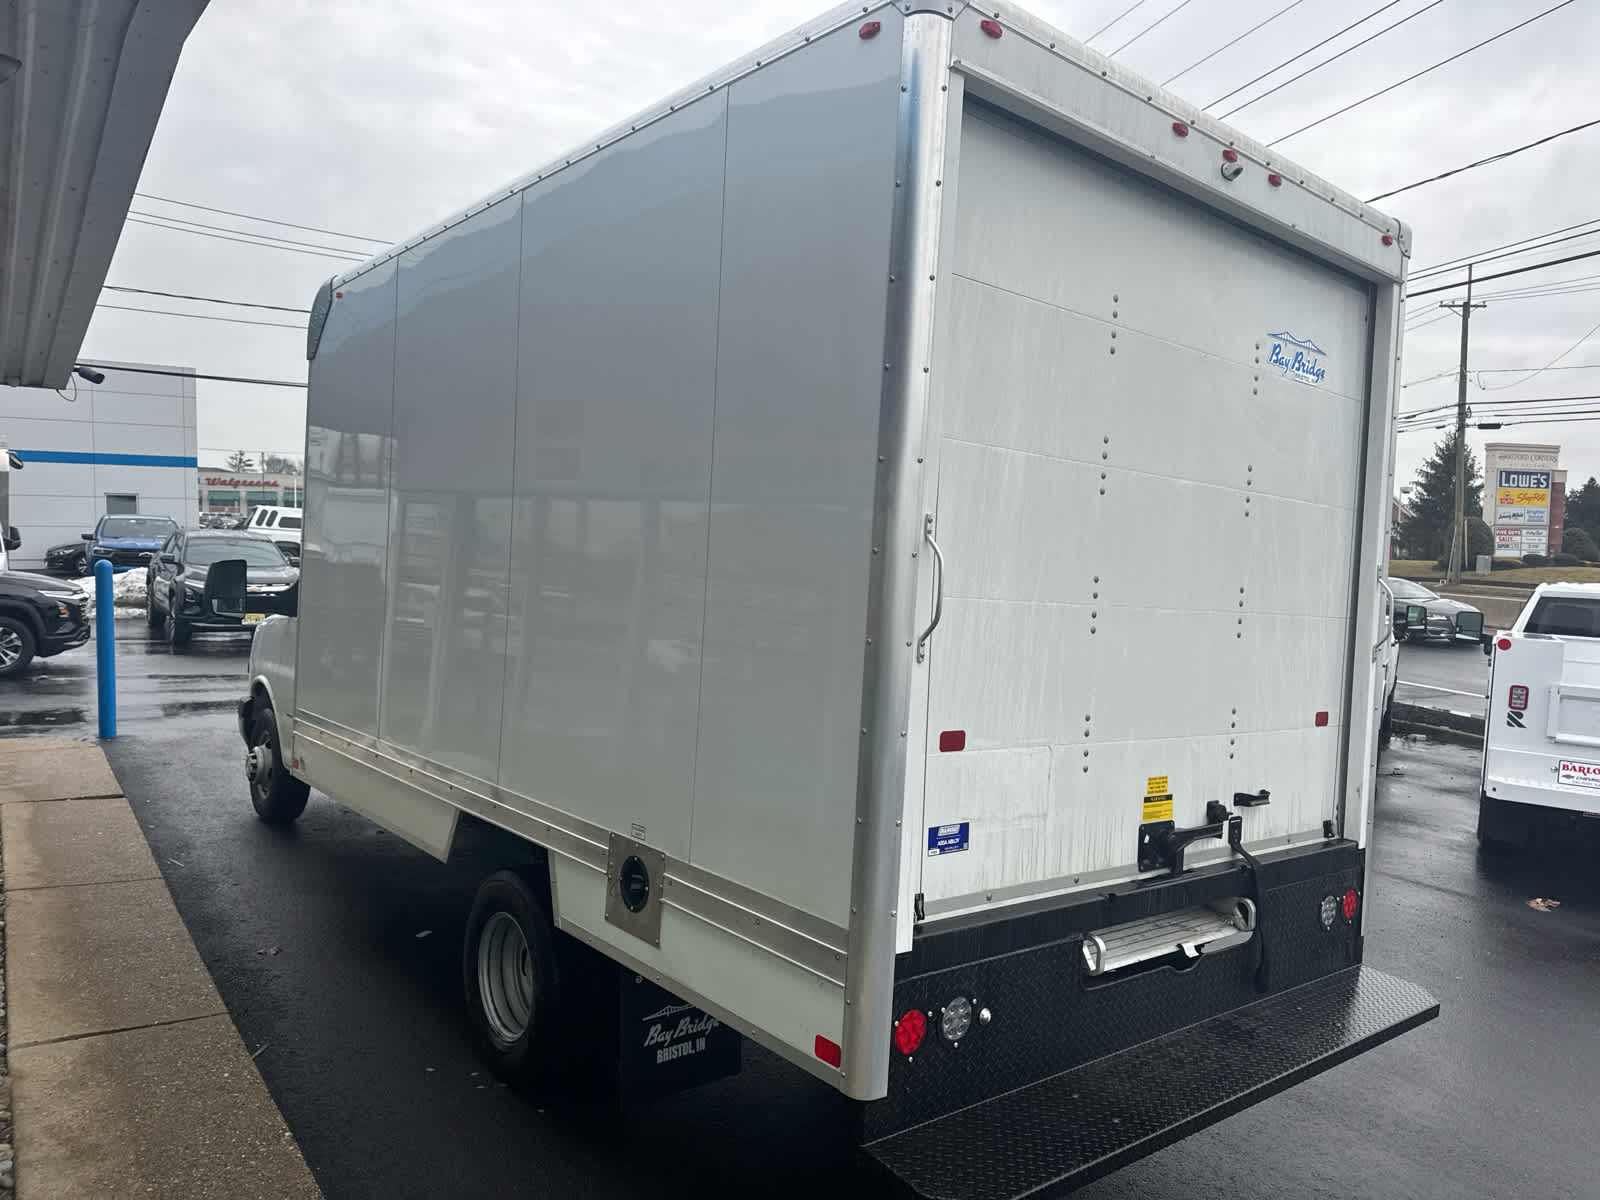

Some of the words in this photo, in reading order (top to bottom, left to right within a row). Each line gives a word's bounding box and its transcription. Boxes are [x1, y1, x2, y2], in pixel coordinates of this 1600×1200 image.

[1269, 343, 1290, 374] Bay
[1291, 351, 1326, 383] Bridge
[205, 478, 279, 488] Walgreens
[1501, 471, 1548, 488] LOWE'S
[643, 1023, 674, 1047] Bay
[696, 1037, 706, 1052] IN
